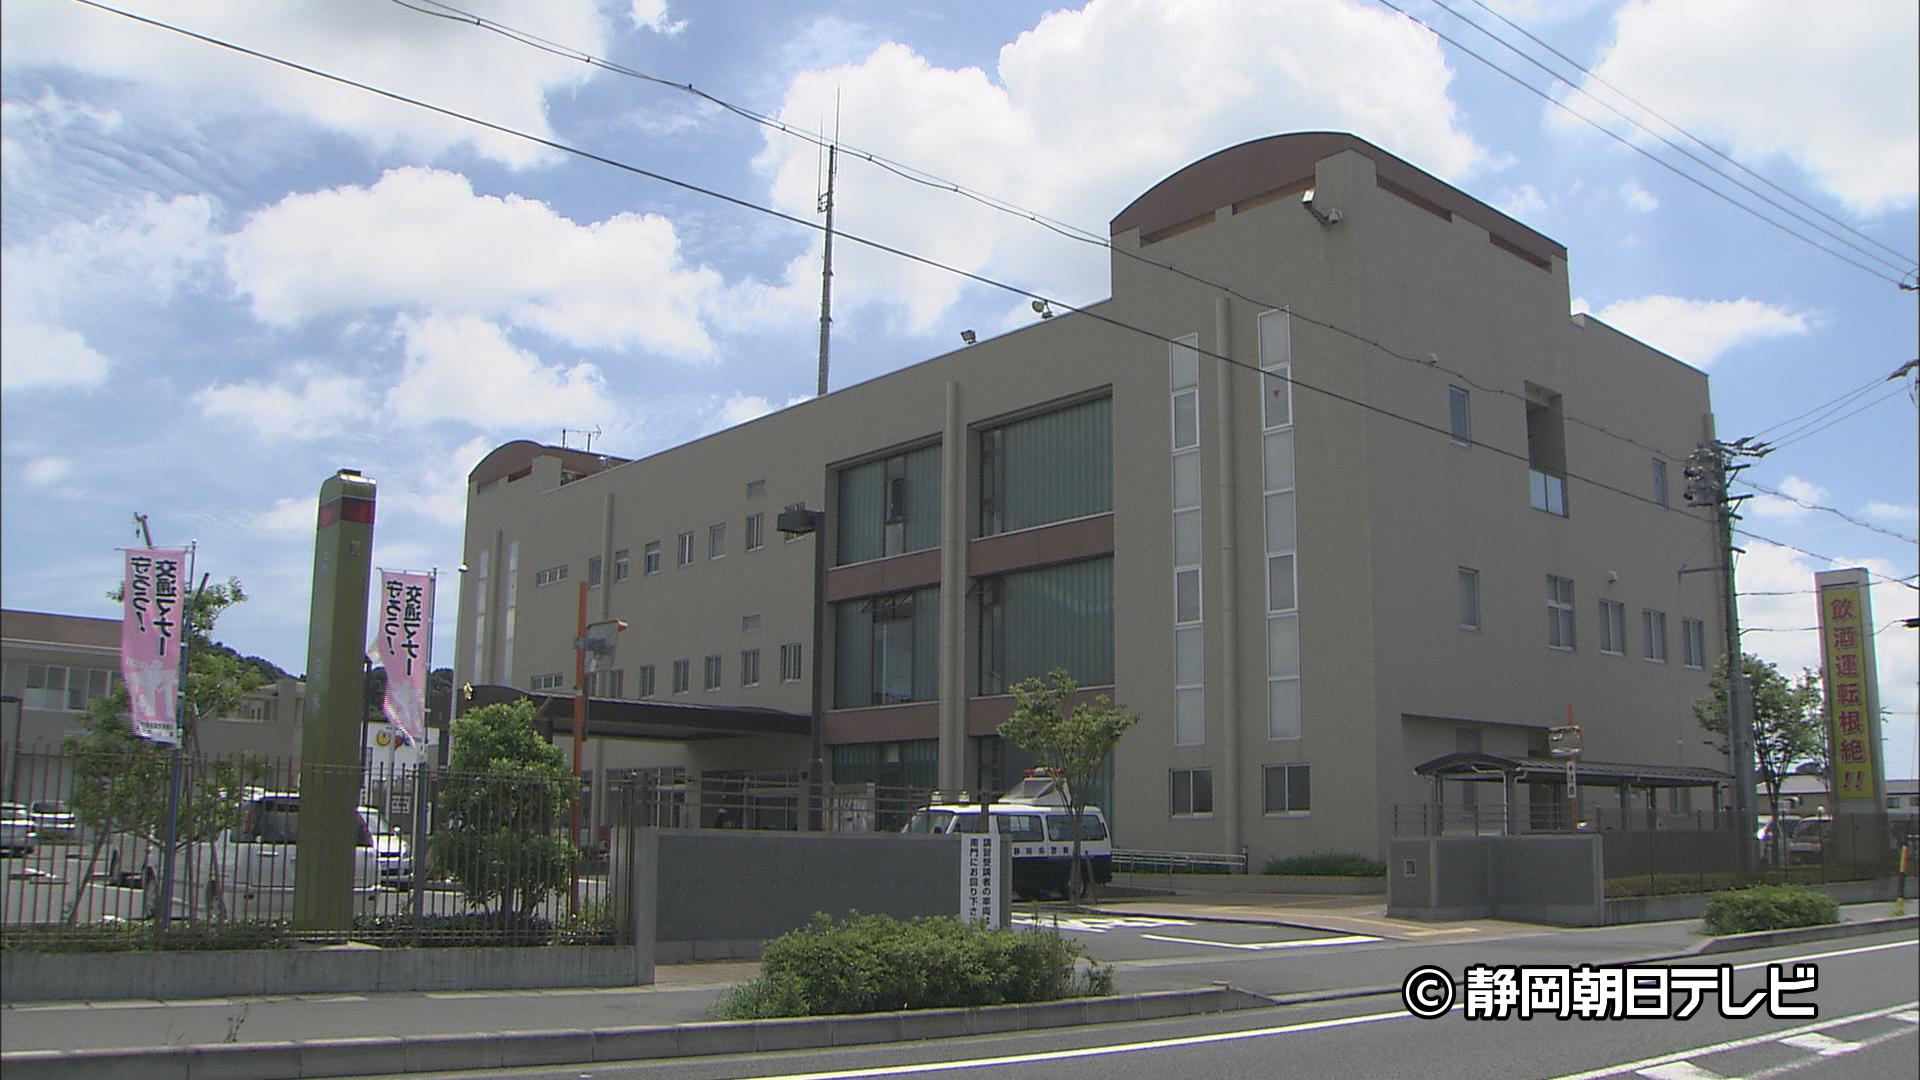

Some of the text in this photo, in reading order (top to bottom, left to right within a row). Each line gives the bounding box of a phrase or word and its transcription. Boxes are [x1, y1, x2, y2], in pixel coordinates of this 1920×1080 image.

[969, 838, 979, 922] 南門にお回り下さ
